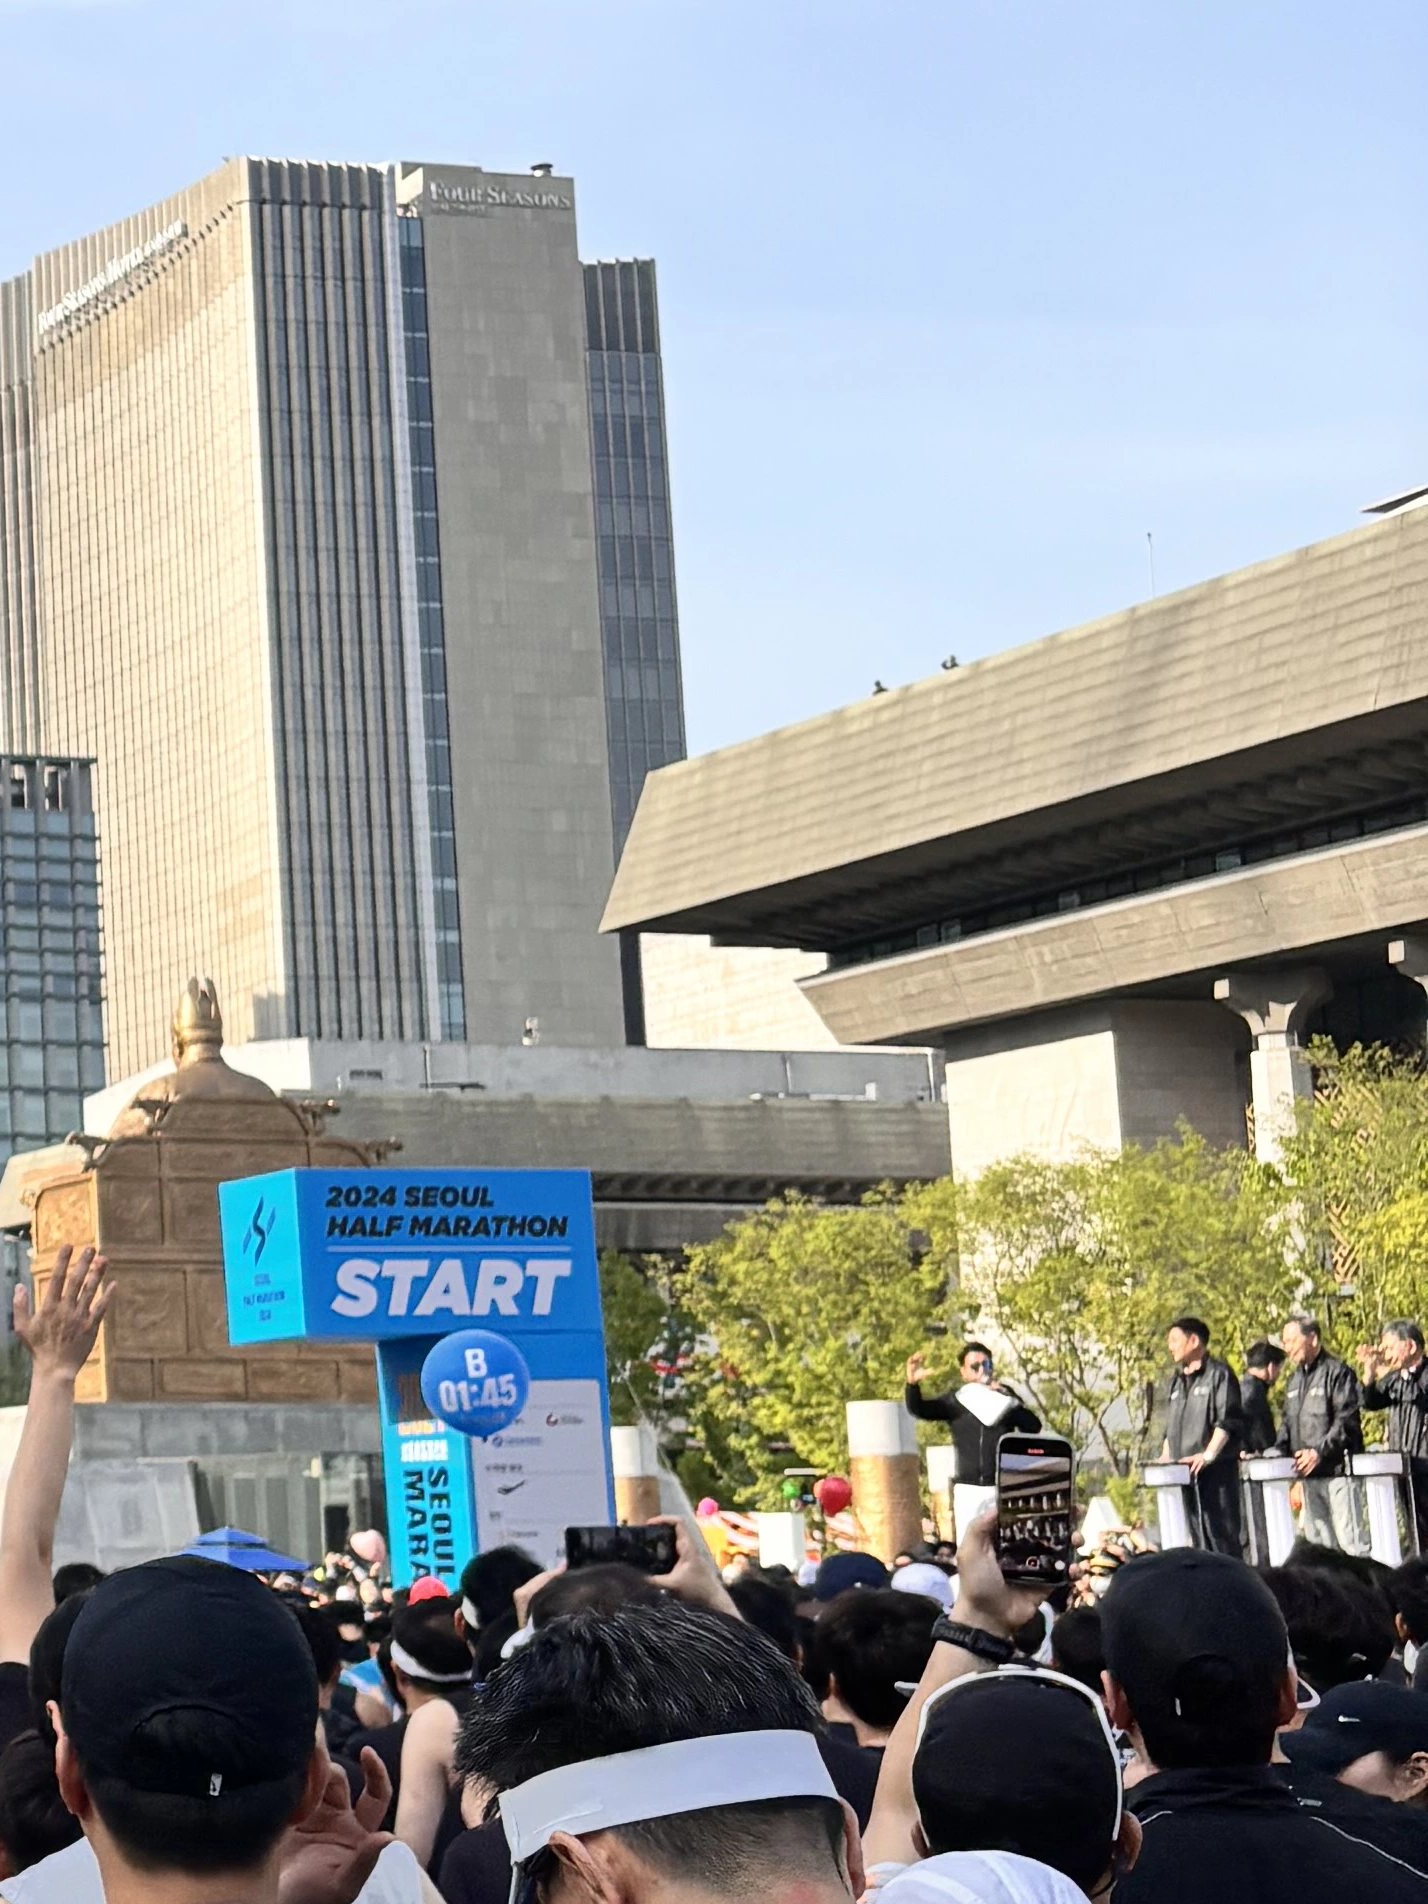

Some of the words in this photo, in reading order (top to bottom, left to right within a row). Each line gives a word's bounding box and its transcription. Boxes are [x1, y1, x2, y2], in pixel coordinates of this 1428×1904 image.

[326, 1185, 397, 1208] 2024
[404, 1185, 494, 1208] SEOUL
[326, 1215, 404, 1238] HALF
[408, 1214, 568, 1238] MARATHON
[330, 1258, 572, 1318] START
[464, 1348, 488, 1379] B
[438, 1373, 517, 1413] 01:45
[427, 1466, 456, 1578] SEOUL
